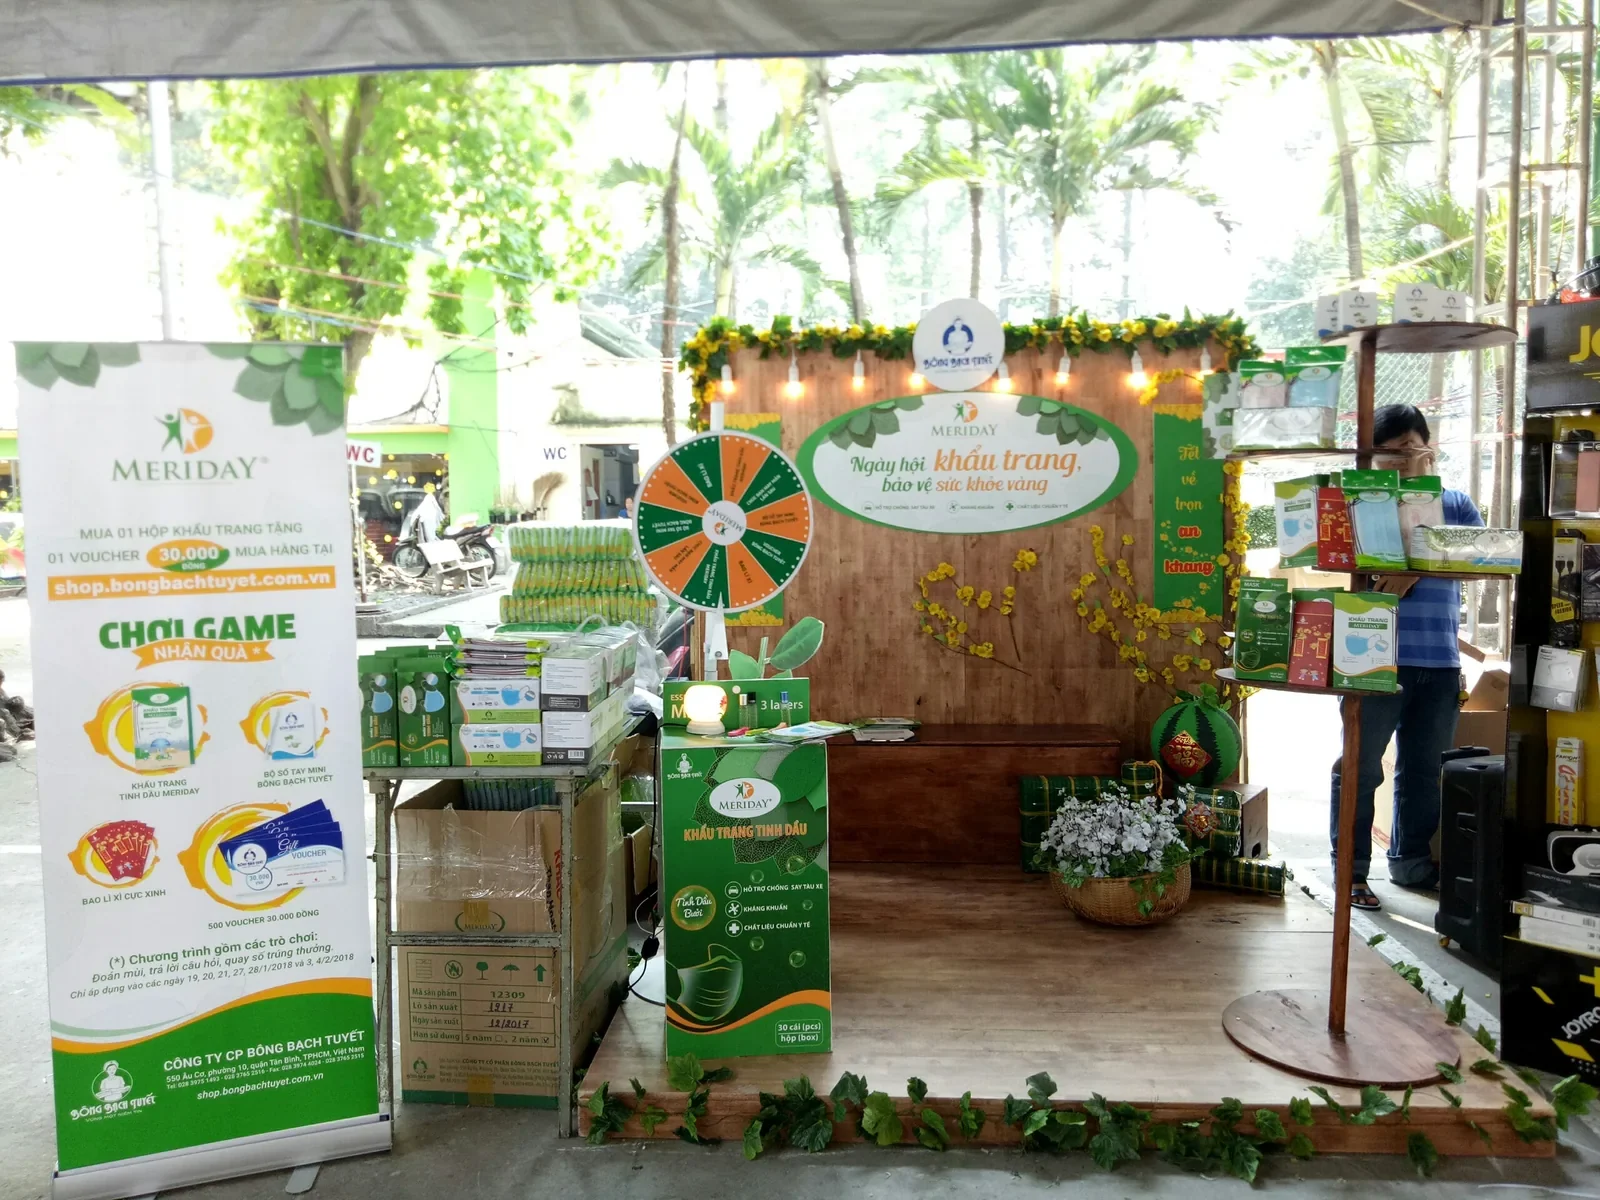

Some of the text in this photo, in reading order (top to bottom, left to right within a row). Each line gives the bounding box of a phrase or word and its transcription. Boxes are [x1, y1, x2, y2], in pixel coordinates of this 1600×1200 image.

[931, 424, 998, 436] MERIDAY
[346, 443, 374, 463] WC
[544, 446, 567, 460] WC
[1178, 444, 1200, 461] Tết
[850, 444, 1082, 478] Ngày hội khẩu trang,
[111, 456, 260, 482] MERIDAY
[882, 475, 1049, 495] bảo vệ sức khỏe vàng
[1175, 496, 1204, 513] trọn
[80, 520, 303, 540] MUA 01 HỘP KHẨU TRANG TẶNG
[1177, 526, 1202, 539] an
[48, 542, 334, 564] 01 VOUCHER 30.000 MUA HÀNG TẠI
[1163, 559, 1215, 576] khang
[54, 572, 331, 597] shop.bongbachtuyet.com.vn
[98, 613, 296, 650] CHƠI GAME
[153, 642, 248, 661] NHẬN QUÀ
[760, 699, 804, 711] 3 laers
[264, 769, 276, 778] BỘ
[291, 767, 305, 775] TAY
[308, 766, 326, 774] MINI
[131, 778, 187, 790] KHẨU TRANG
[257, 774, 333, 788] BÔNG BẠCH TUYẾT
[119, 787, 200, 801] TINH DẦU MERIDAY
[719, 799, 768, 810] MERIDAY
[684, 819, 808, 842] KHẨU TRANG TINH DẦU
[277, 839, 299, 856] Gift
[292, 849, 327, 860] VOUCHER
[249, 873, 270, 882] 30.000
[743, 884, 752, 893] HỖ
[753, 885, 766, 893] TRỢ
[767, 883, 789, 892] CHỐNG
[82, 889, 166, 905] BAO LÌ XÌ CỰC XINH
[676, 894, 713, 907] Tinh Dầu
[743, 905, 766, 913] KHÁNG
[208, 909, 319, 930] 500 VOUCHER 30.000 ĐỒNG
[744, 922, 760, 931] CHẤT
[761, 922, 775, 931] LIỆU
[776, 920, 797, 929] CHUẨN
[803, 921, 811, 929] TẾ
[129, 951, 179, 966] Chương
[182, 945, 210, 959] trình
[214, 942, 241, 957] gồm
[245, 939, 266, 951] các
[269, 936, 286, 947] trò
[289, 931, 318, 943] chơi:
[92, 943, 333, 983] Đoán mùi, trả lời câu hỏi, quay số trúng thưởng.
[70, 953, 354, 999] Chỉ áp dụng vào các ngày 19, 20, 21, 27, 28/1/2018 và 3, 4/2/2018
[412, 988, 423, 996] Mã
[491, 991, 526, 999] 12309
[424, 1001, 438, 1011] sản
[439, 1002, 458, 1012] xuất
[789, 1022, 801, 1031] cái
[802, 1022, 821, 1032] (pcs)
[780, 1033, 819, 1043] hộp (box)
[163, 1028, 365, 1071] CÔNG TY CP BÔNG BẠCH TUYẾT
[197, 1072, 324, 1099] shop.bongbachtuyet.com.vn
[70, 1105, 102, 1120] BÔNG
